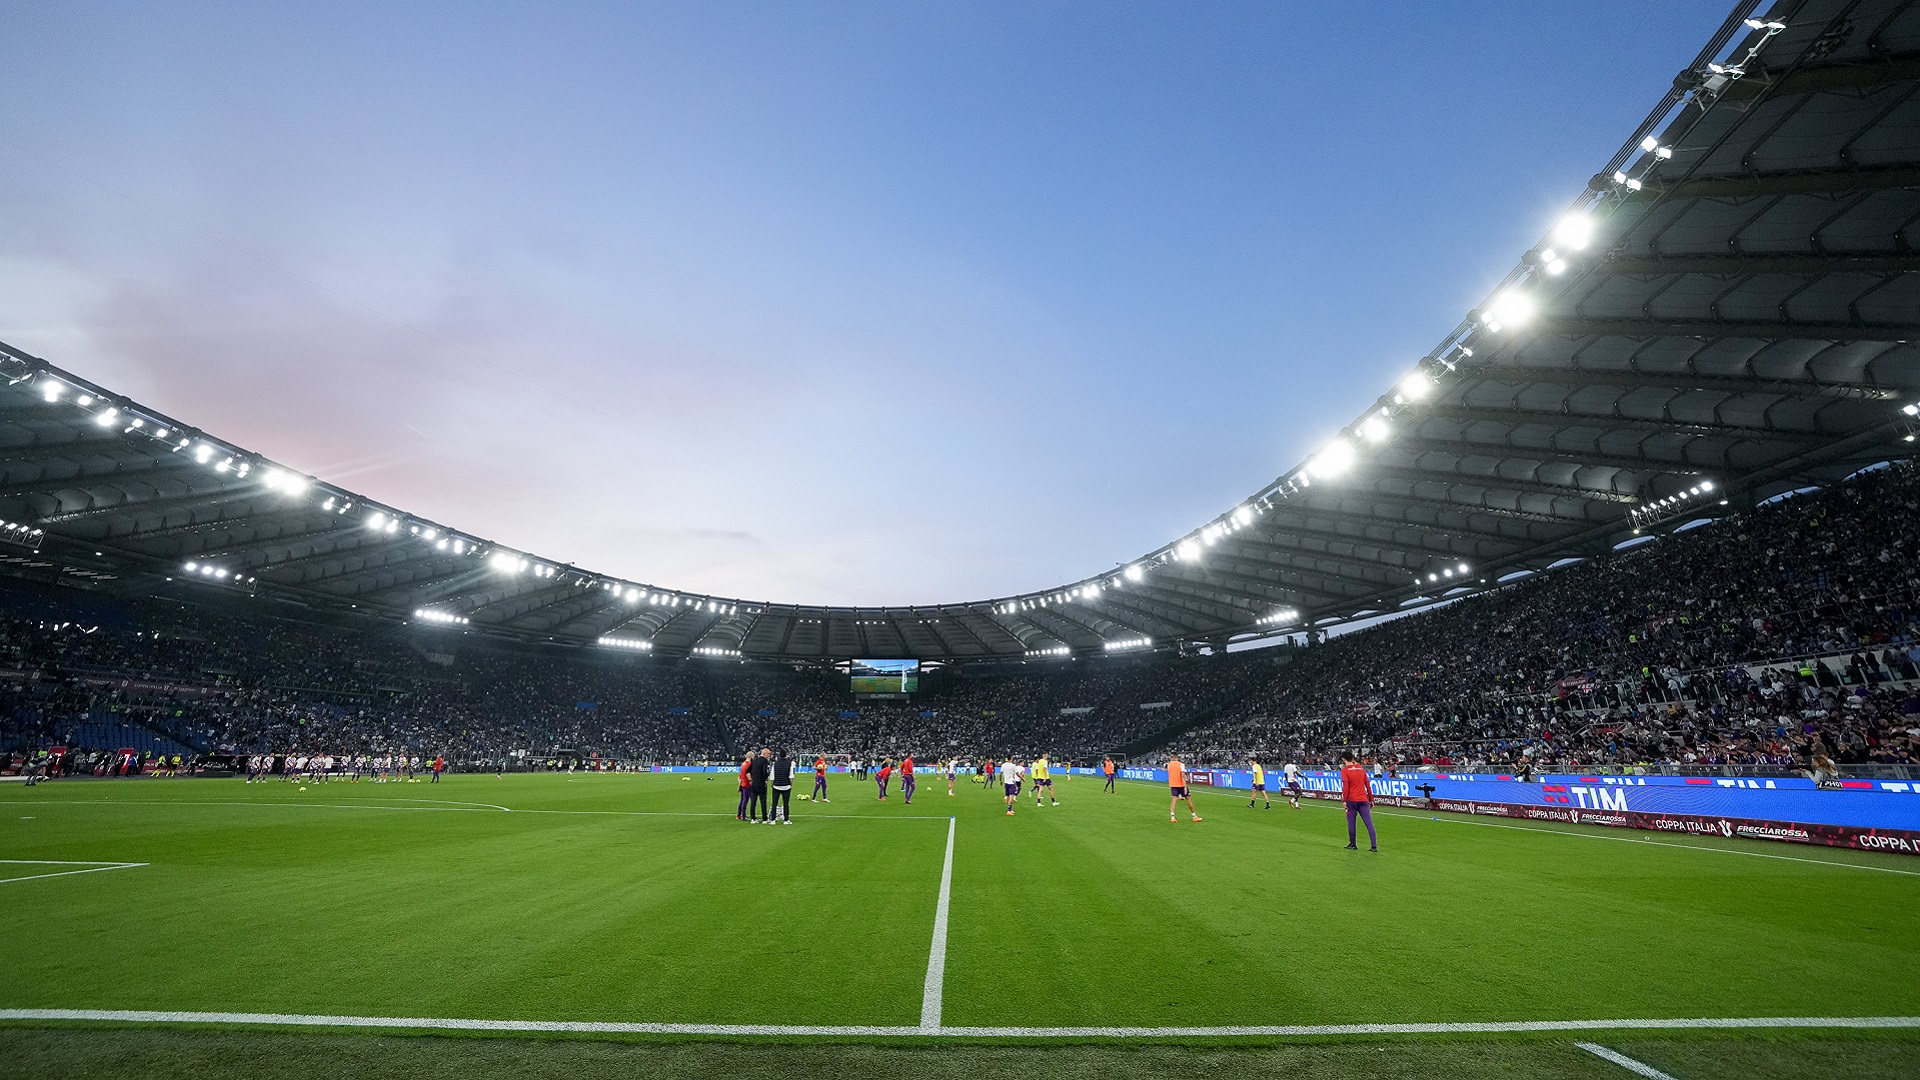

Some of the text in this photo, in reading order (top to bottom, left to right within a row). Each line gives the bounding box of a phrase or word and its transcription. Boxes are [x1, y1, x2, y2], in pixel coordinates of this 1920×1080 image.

[1366, 779, 1410, 797] OWER
[1439, 802, 1454, 810] COPPA
[1453, 803, 1469, 812] ITALIA
[1571, 787, 1629, 811] TIM
[1528, 809, 1627, 823] COPPA ITALIA FRECCIAROSSA
[1655, 819, 1809, 838] COPPA ITALIA FRECCIAROSSA
[1860, 834, 1911, 851] COPPA
